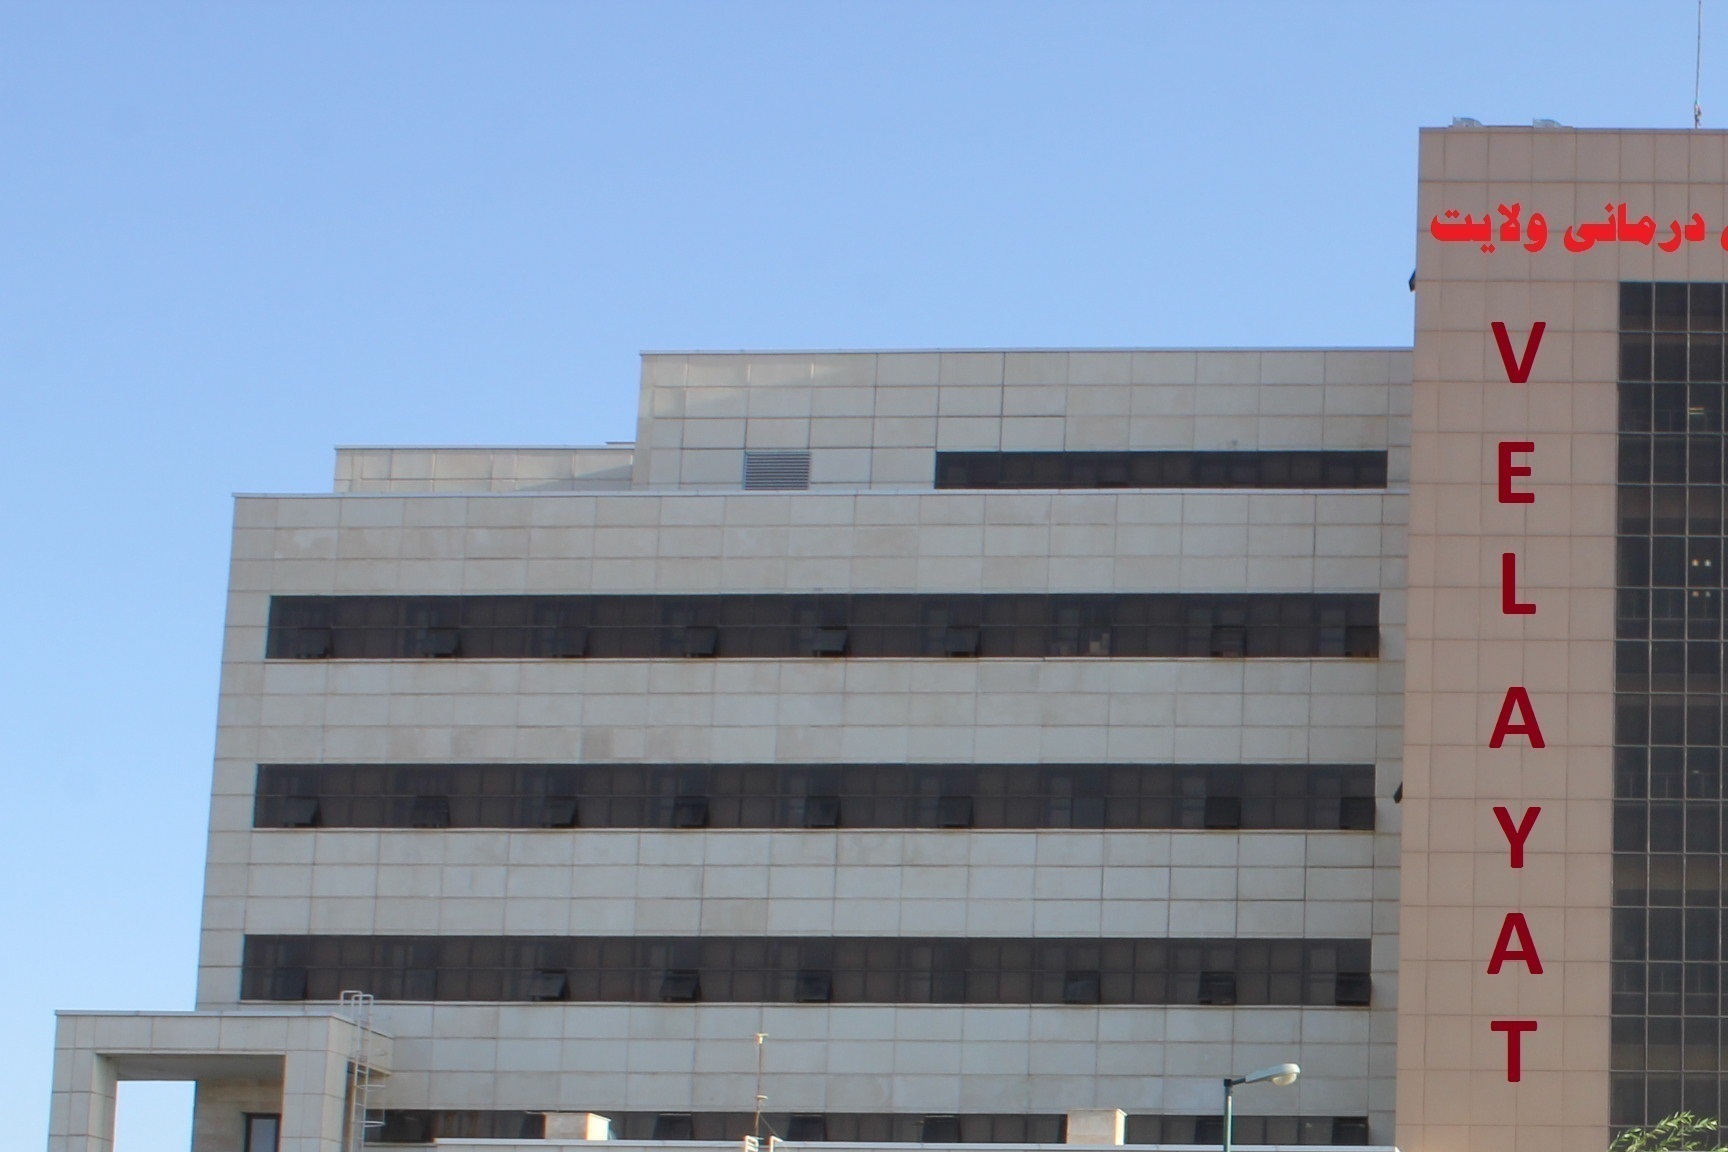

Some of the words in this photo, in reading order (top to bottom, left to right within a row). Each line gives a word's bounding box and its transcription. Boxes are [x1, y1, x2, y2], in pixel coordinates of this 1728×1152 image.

[1431, 204, 1549, 254] ولایت
[1564, 204, 1707, 254] درمانی
[1487, 322, 1547, 1084] VELAYAT
